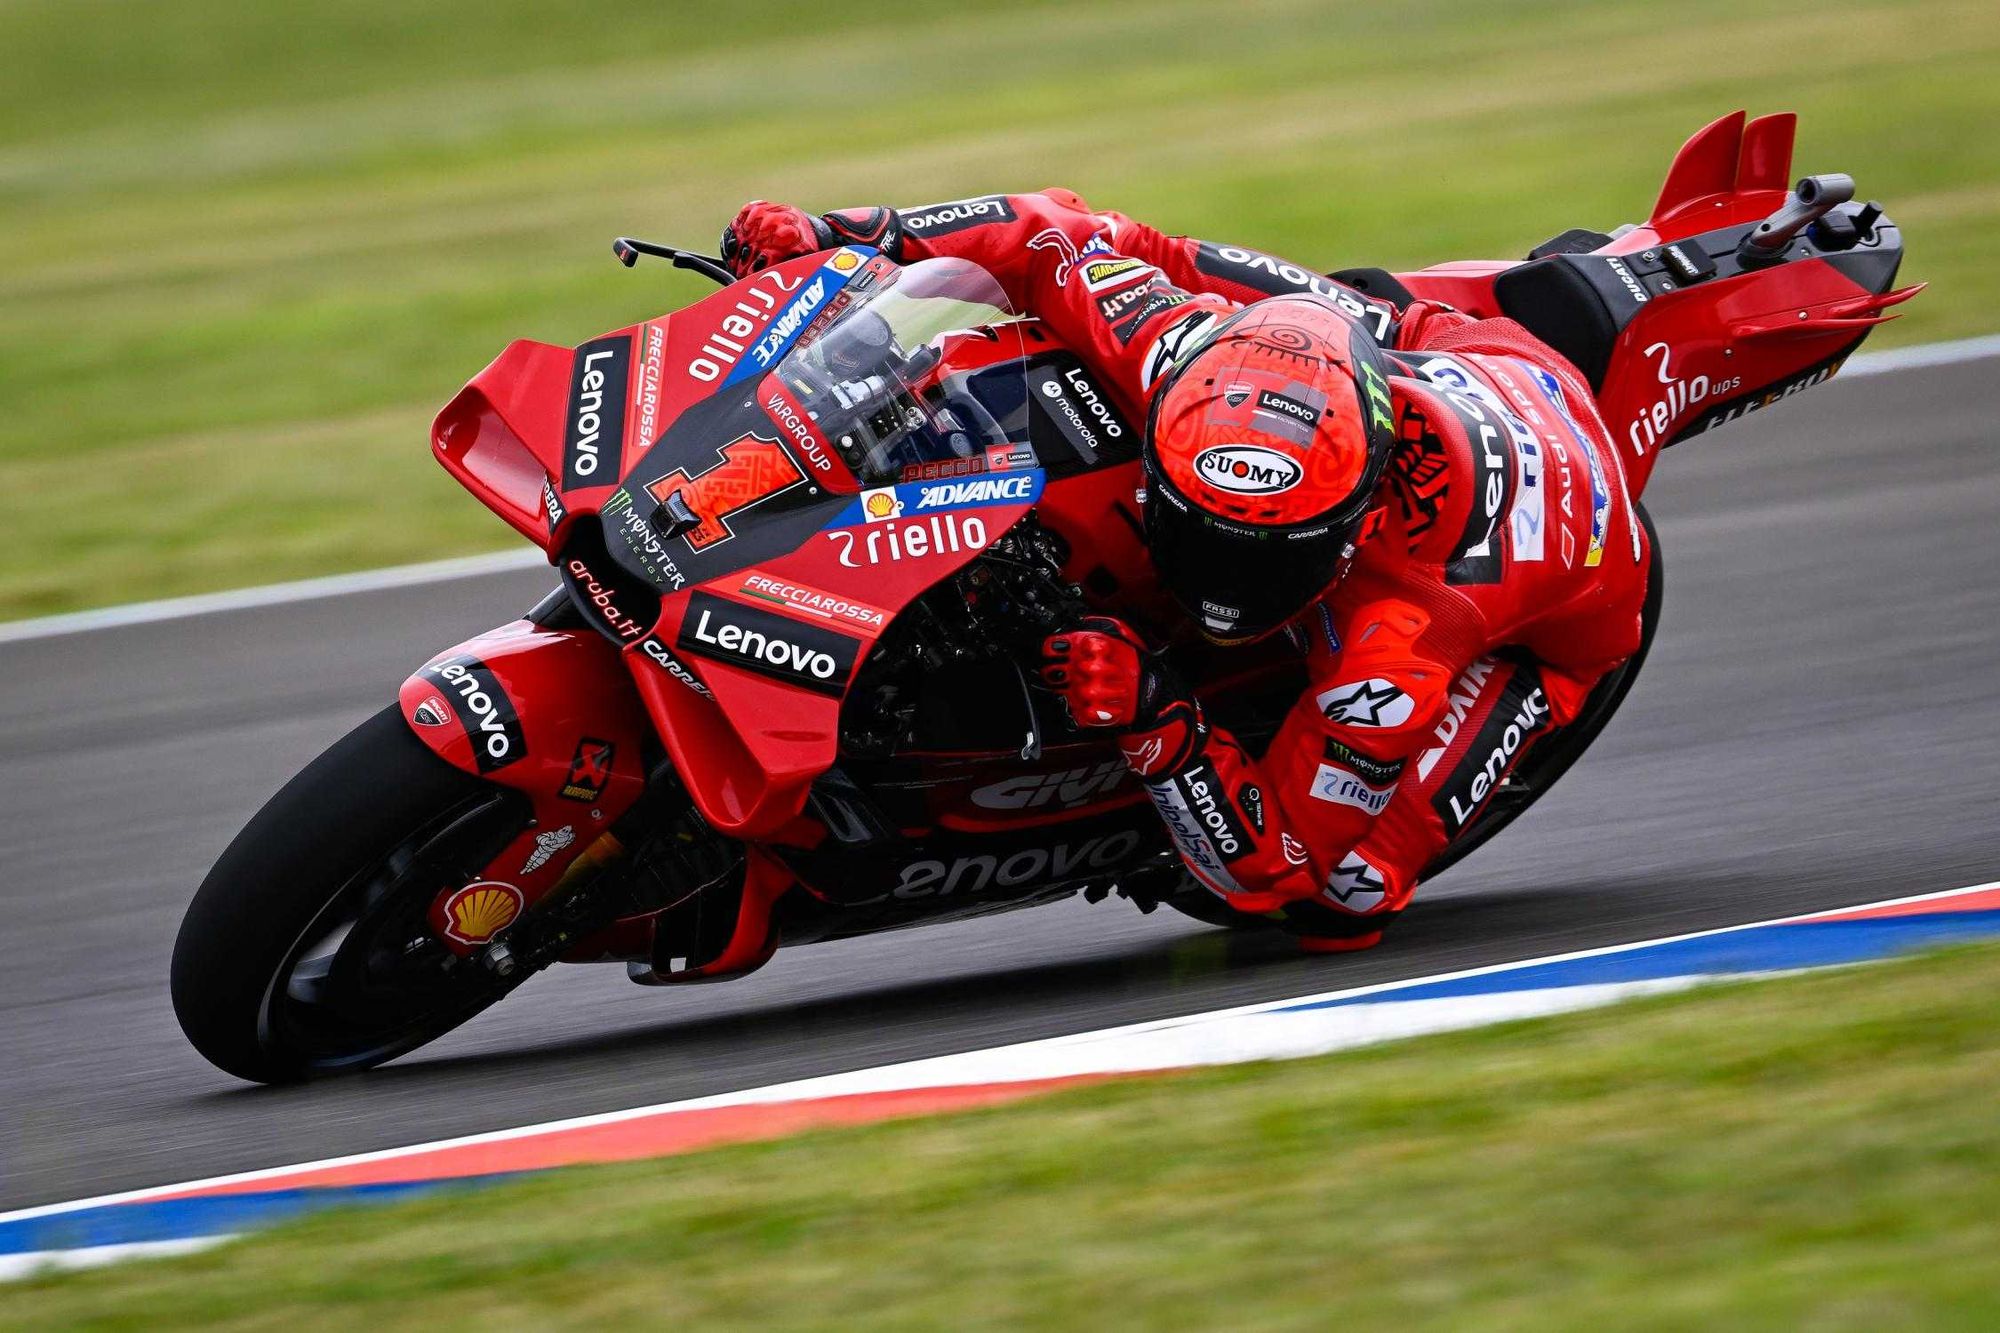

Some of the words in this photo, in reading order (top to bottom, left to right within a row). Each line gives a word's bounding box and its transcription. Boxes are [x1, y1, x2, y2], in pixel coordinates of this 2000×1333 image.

[908, 200, 1006, 229] Lenovo
[1217, 247, 1391, 341] Lenovo
[1606, 257, 1648, 302] DUCATI
[689, 287, 776, 382] riello
[752, 276, 824, 367] ADVANCE
[575, 350, 613, 476] Lenovo
[639, 325, 664, 448] FRECCIAROSSA
[1065, 368, 1122, 437] Lenovo
[1263, 393, 1314, 421] Lenovo
[1630, 375, 1709, 457] riello
[1056, 398, 1098, 448] motorola
[903, 456, 985, 484] PECCO
[1007, 453, 1031, 461] Lenovo
[1204, 451, 1294, 489] SUOMY
[643, 431, 809, 554] 1
[916, 476, 1033, 509] ADVANCE
[1158, 484, 1188, 512] CARRERA
[619, 528, 664, 584] ENERGY
[622, 506, 685, 591] MONSTER
[865, 514, 988, 564] riello
[1288, 527, 1329, 540] CARRERA
[744, 575, 883, 626] FRECCIAROSSA
[695, 609, 836, 679] Lenovo
[429, 657, 510, 758] Lenovo
[1183, 765, 1239, 854] Lenovo
[893, 829, 1140, 899] enovo
